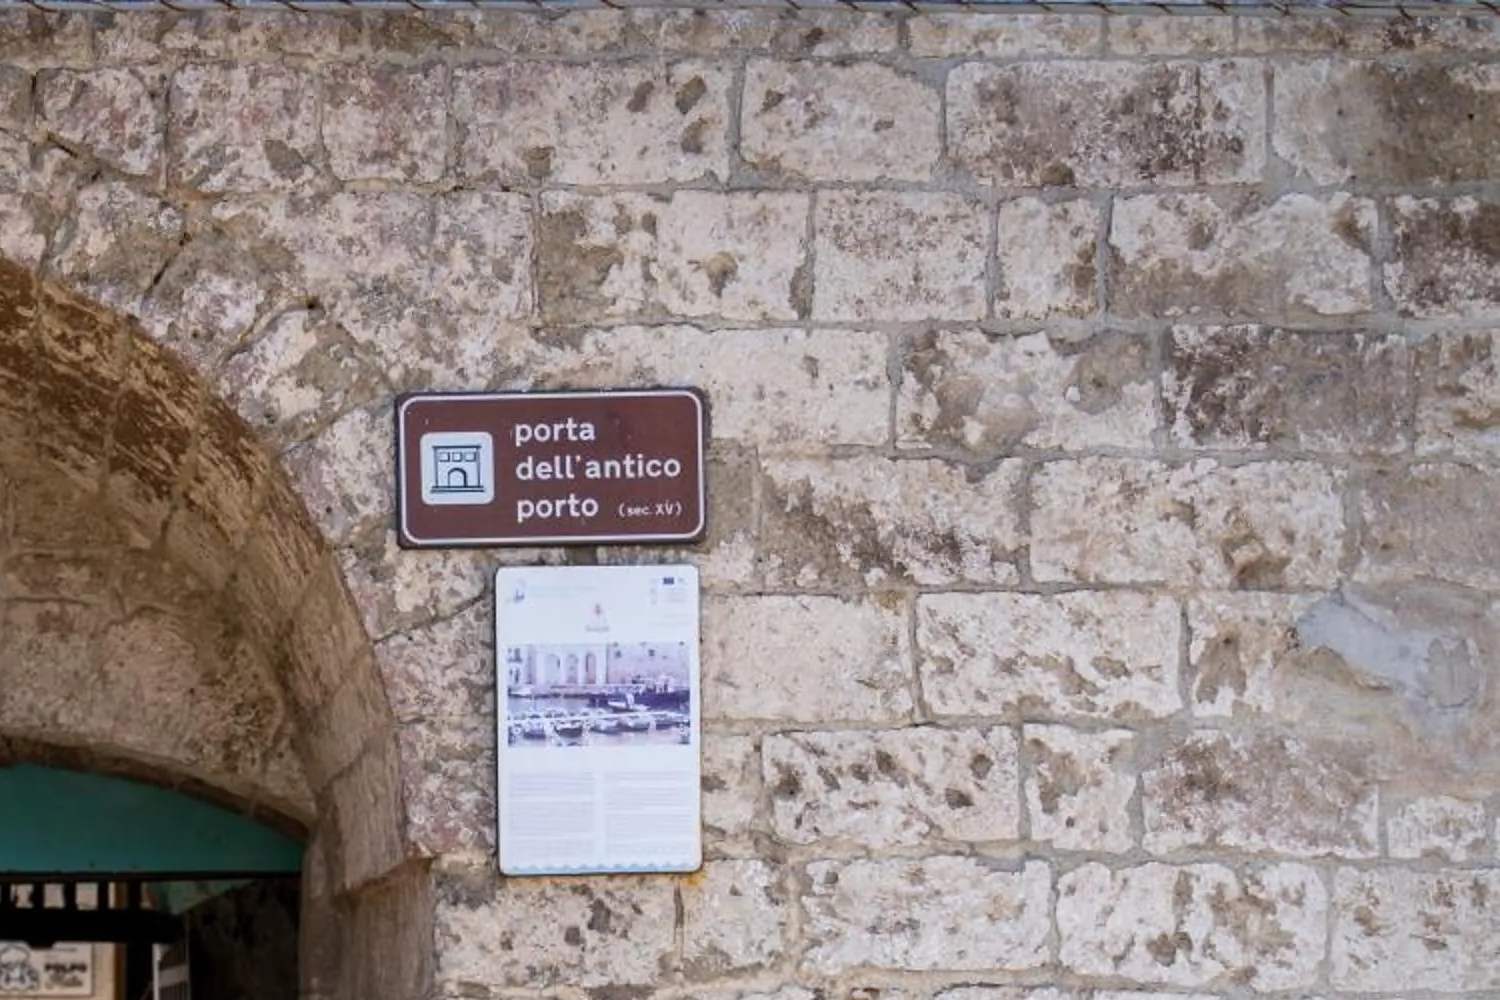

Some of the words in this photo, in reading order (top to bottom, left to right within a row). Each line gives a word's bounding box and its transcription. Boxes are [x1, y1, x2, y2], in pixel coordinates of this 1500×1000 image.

[515, 417, 595, 447] porta
[515, 453, 681, 480] dell'antico
[516, 493, 599, 523] porto
